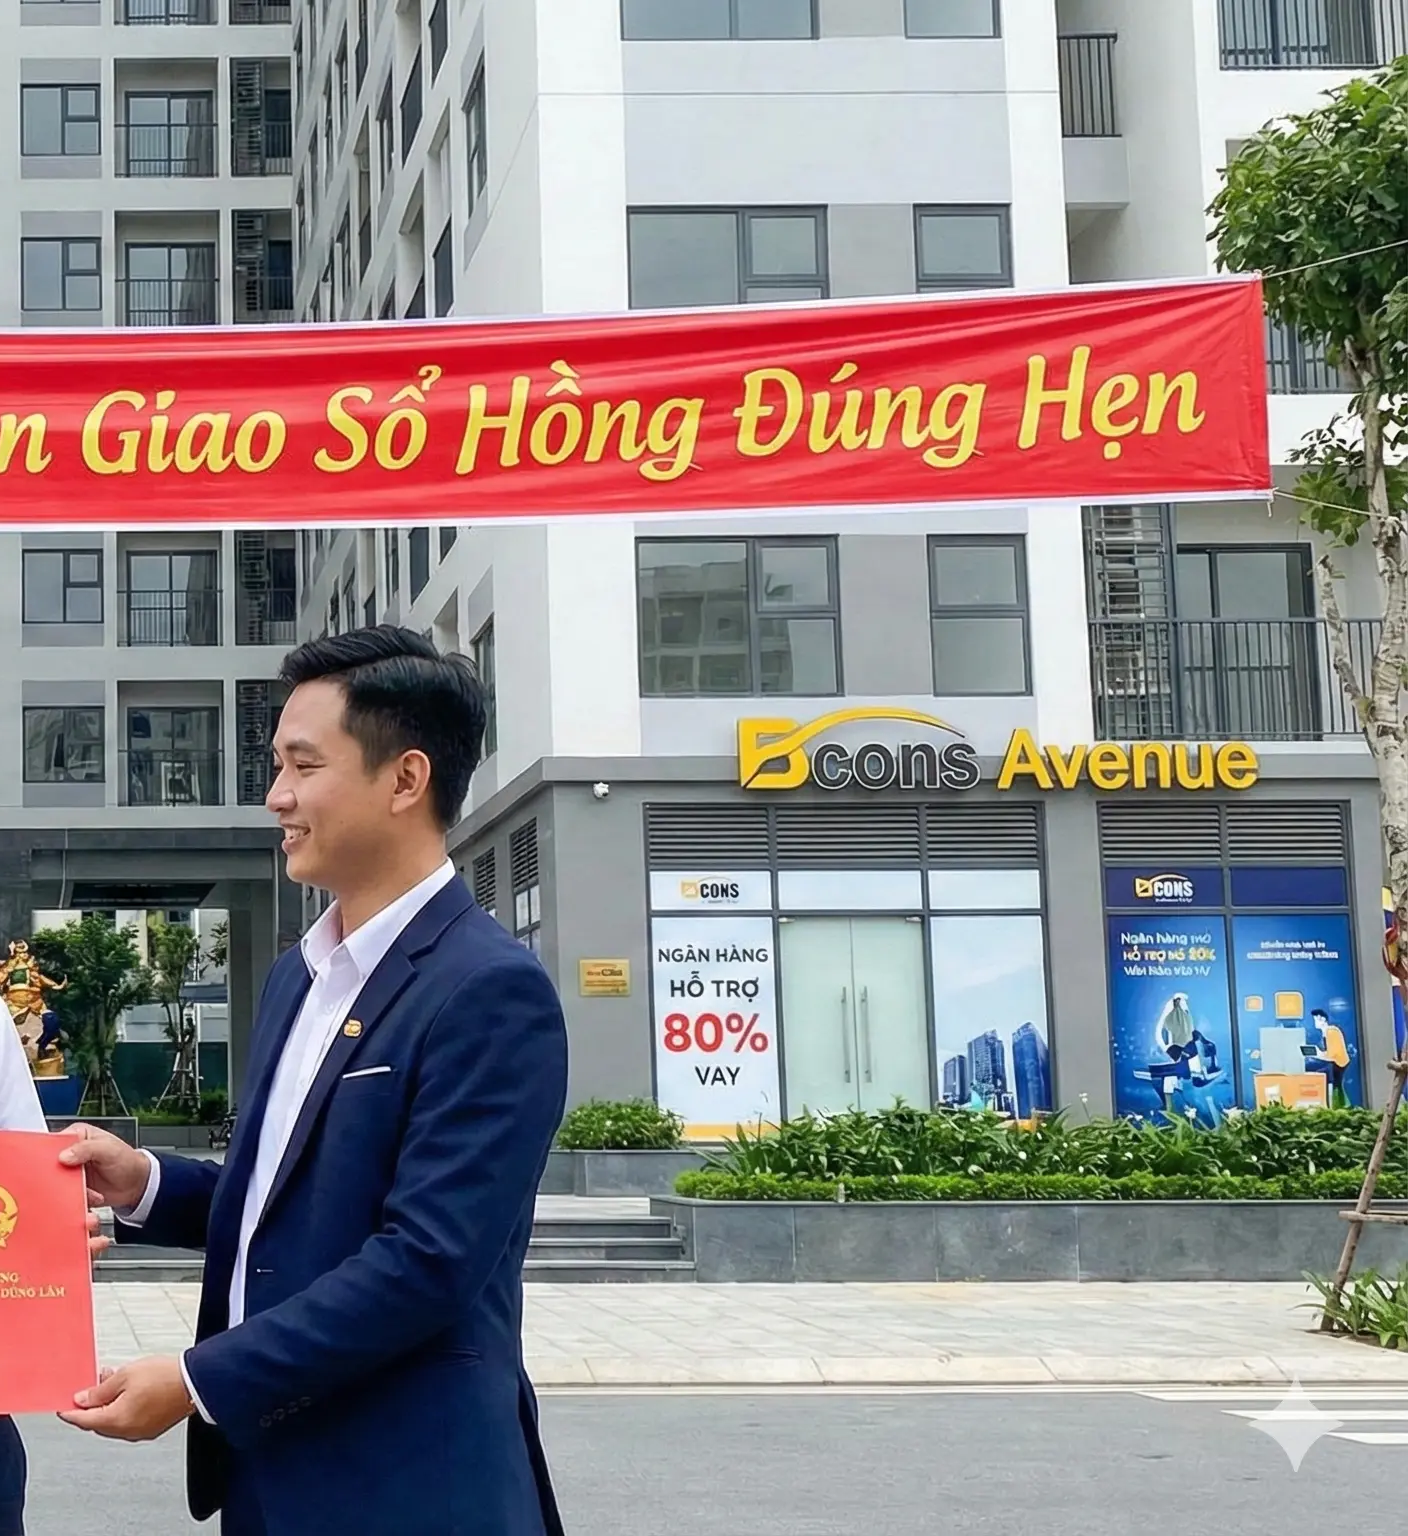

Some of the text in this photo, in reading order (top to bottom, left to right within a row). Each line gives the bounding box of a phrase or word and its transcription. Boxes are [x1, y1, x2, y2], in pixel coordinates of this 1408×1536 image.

[82, 390, 286, 474] Giao
[314, 364, 442, 472] Sổ
[455, 360, 704, 481] Hồng
[732, 362, 987, 468] Đúng
[1018, 345, 1205, 460] Hẹn
[997, 728, 1259, 791] Avenue
[715, 944, 769, 963] HÀNG
[670, 970, 760, 1003] HỖ TRỢ
[664, 1012, 769, 1054] 80%
[694, 1066, 741, 1086] VAY
